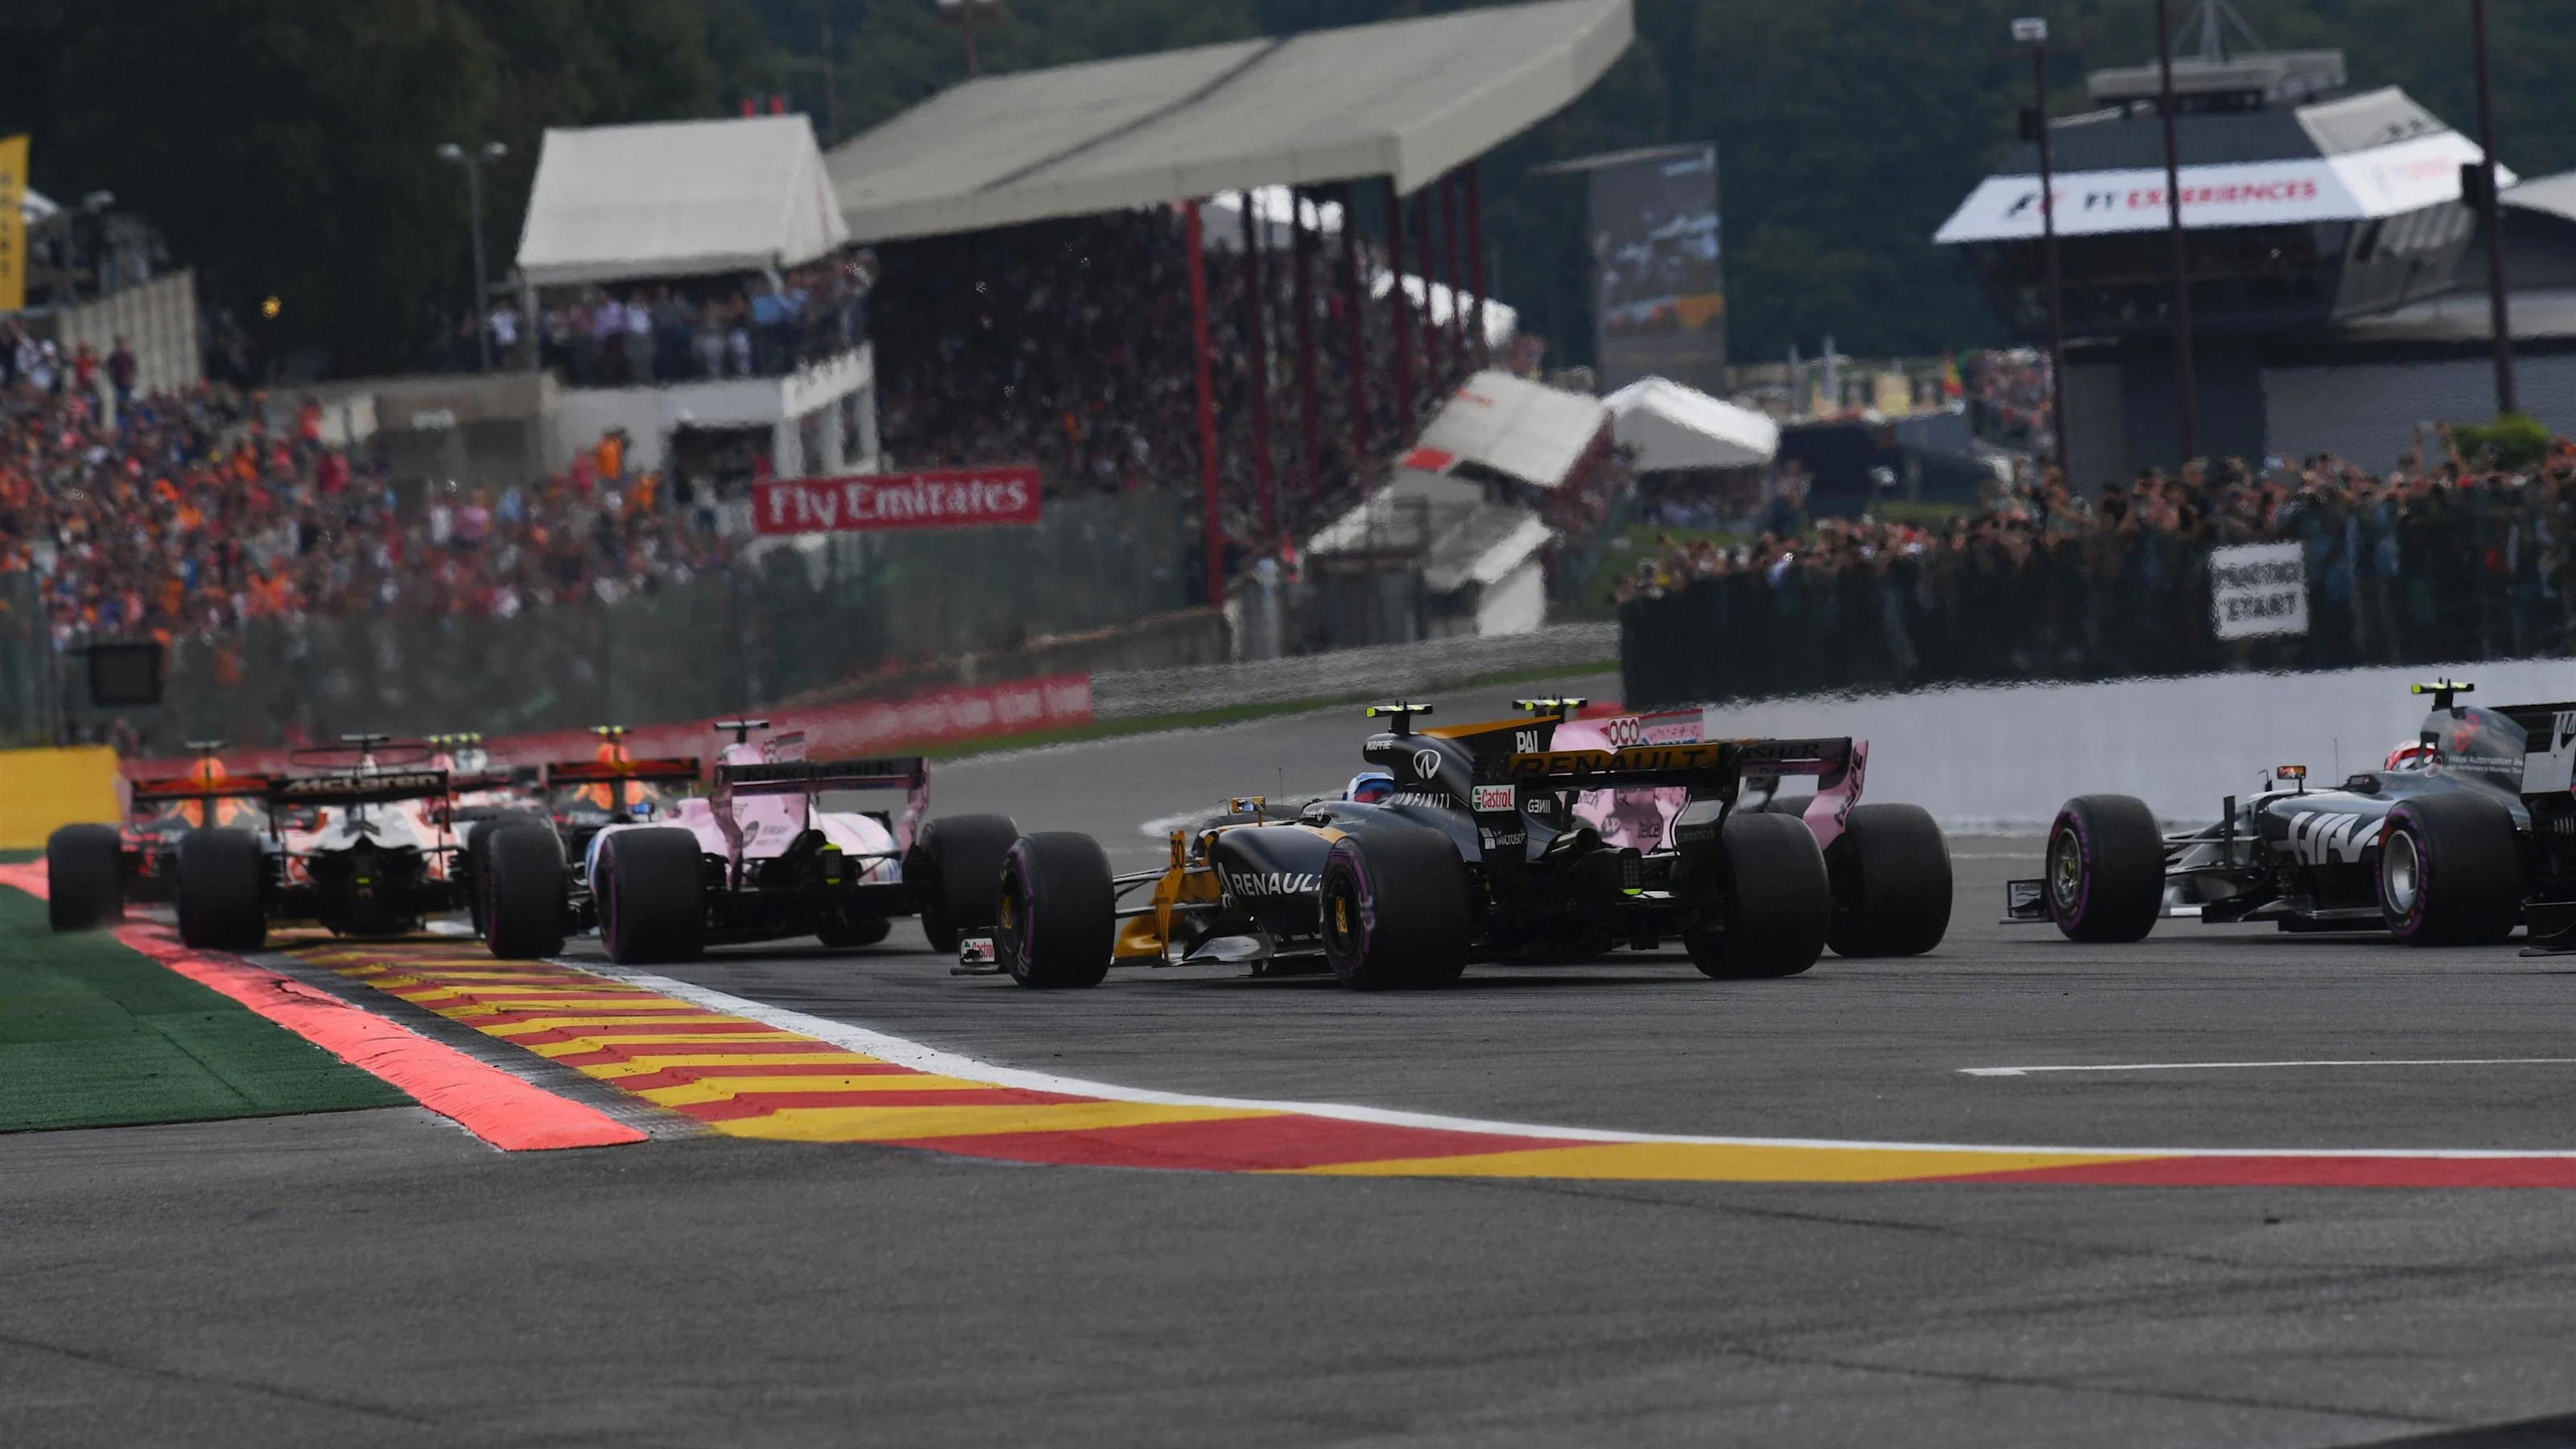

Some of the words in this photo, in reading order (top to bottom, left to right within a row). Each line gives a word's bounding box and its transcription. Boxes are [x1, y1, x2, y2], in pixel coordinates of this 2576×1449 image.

[2126, 178, 2318, 210] EXERIENCES
[768, 482, 838, 527] Fly
[844, 477, 1028, 520] Emirates
[1609, 719, 1639, 745] OCO
[1365, 740, 1393, 751] MAPFRE
[744, 760, 896, 782] KINGFISHER
[1514, 749, 1708, 775] RENAULT
[2470, 755, 2512, 766] Automation
[283, 774, 440, 792] McLaren
[1397, 792, 1450, 809] INFINITI
[1481, 788, 1513, 810] Castrol
[1170, 839, 1185, 869] 30
